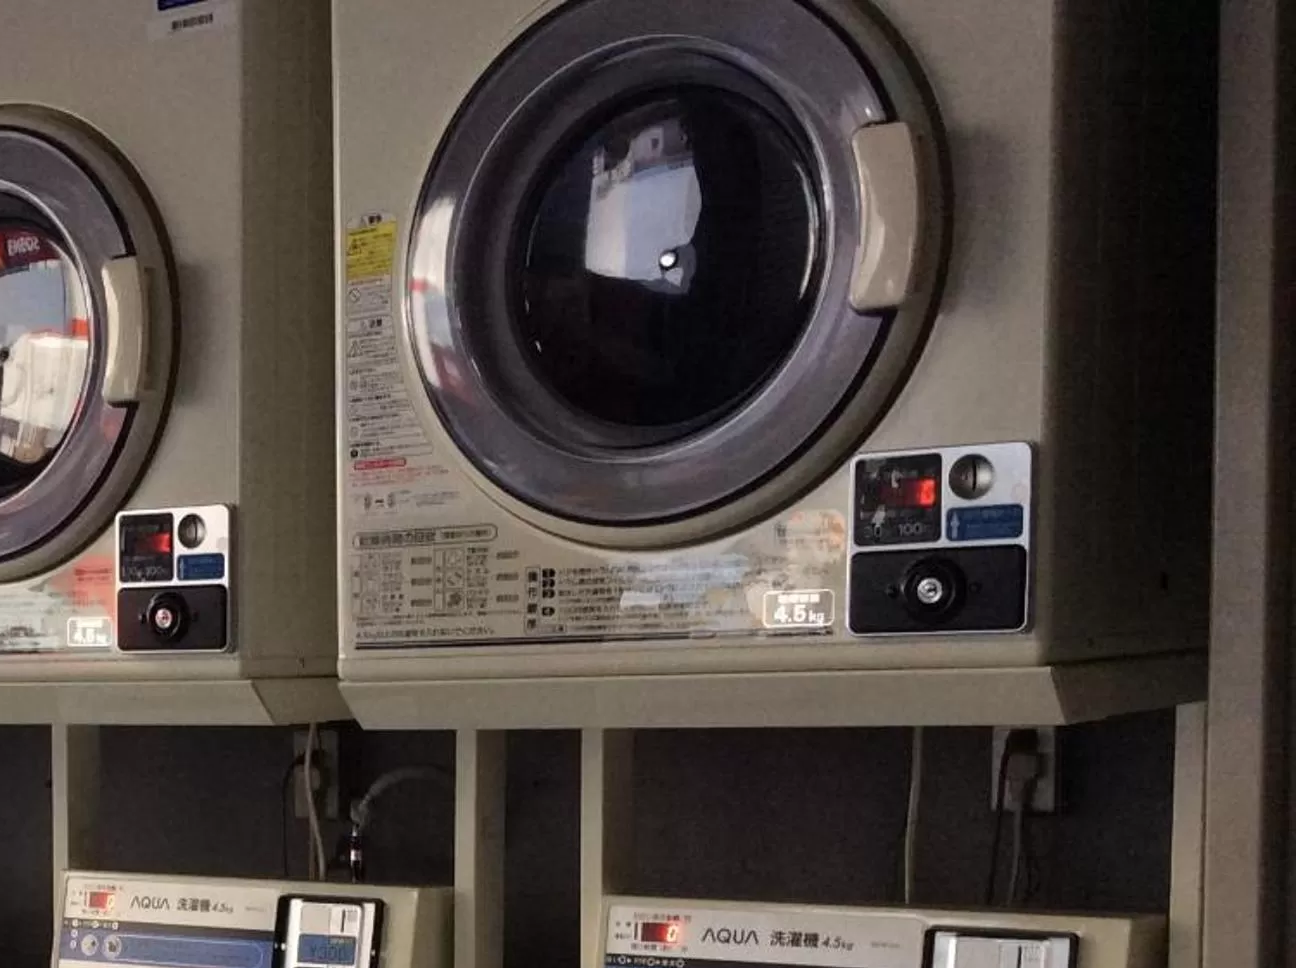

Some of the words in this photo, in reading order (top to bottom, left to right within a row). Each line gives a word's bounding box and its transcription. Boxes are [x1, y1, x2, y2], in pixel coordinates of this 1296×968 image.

[130, 895, 170, 911] AQUA
[702, 927, 760, 945] AQUA
[770, 930, 820, 948] 洗濯機
